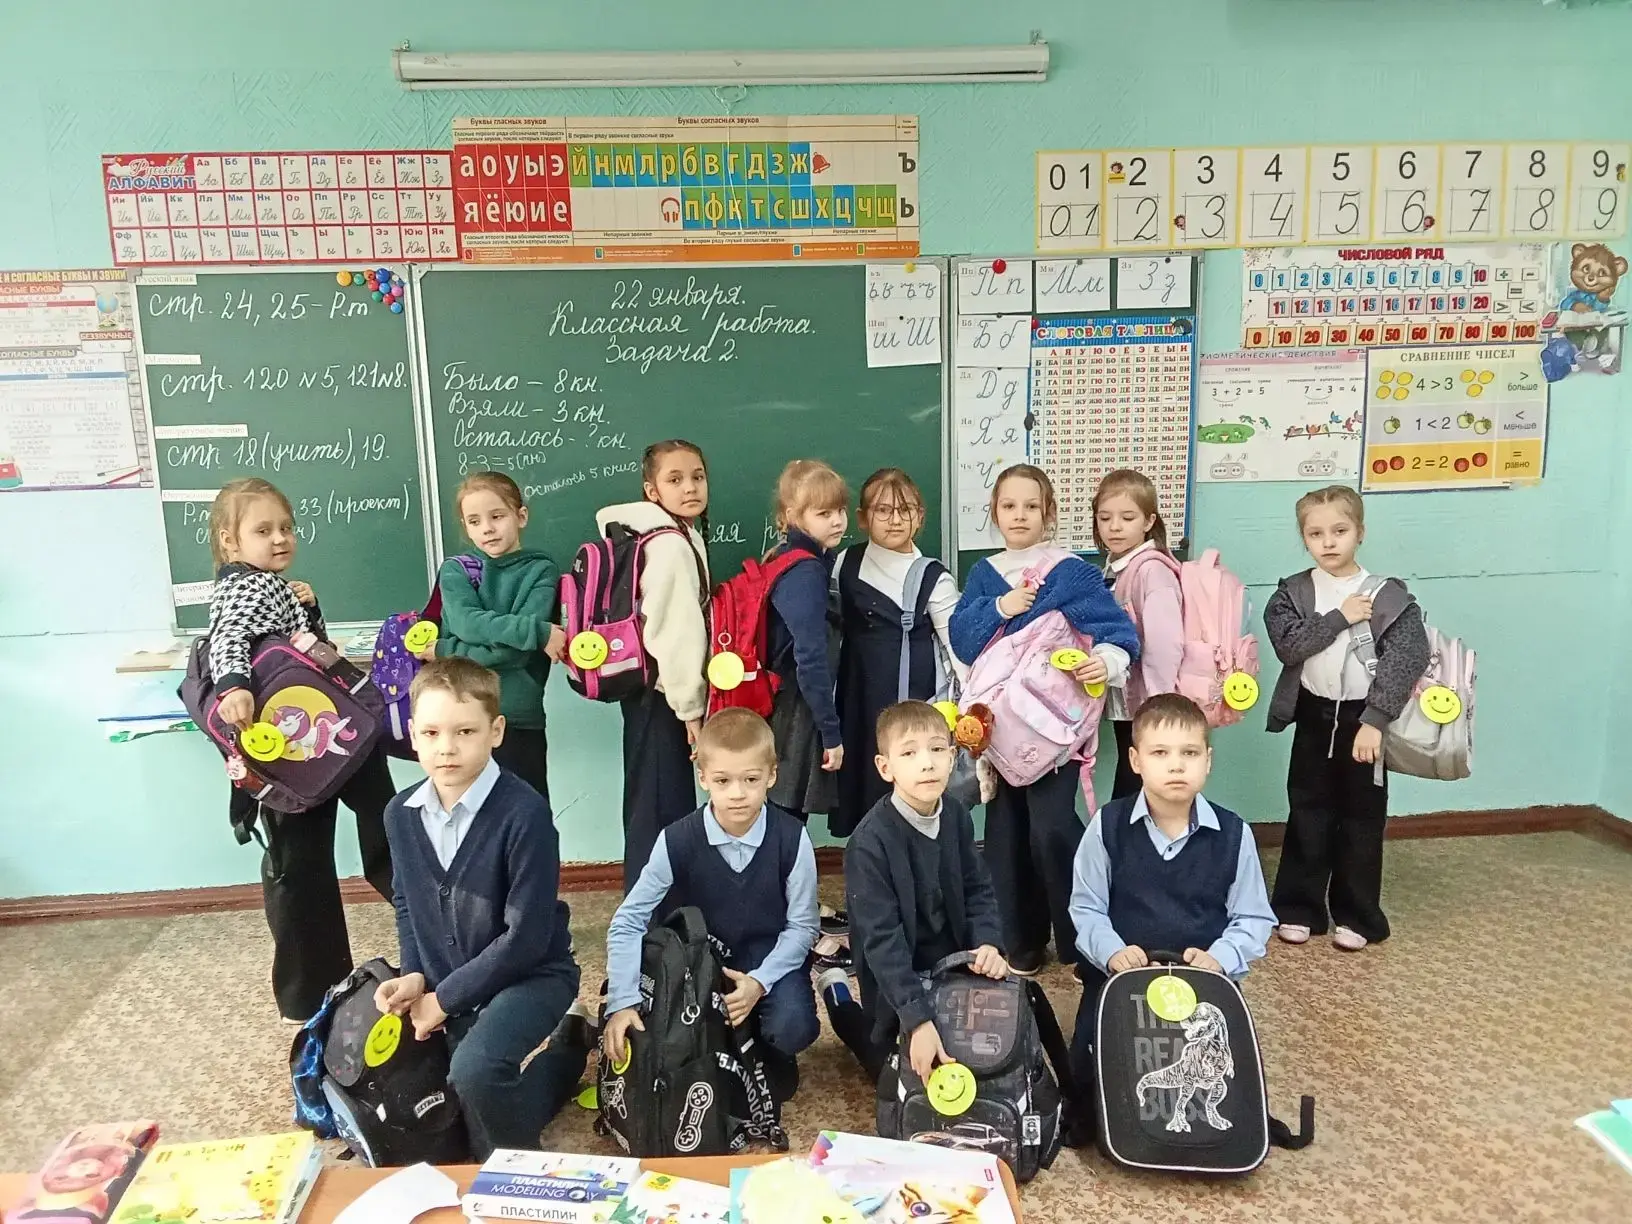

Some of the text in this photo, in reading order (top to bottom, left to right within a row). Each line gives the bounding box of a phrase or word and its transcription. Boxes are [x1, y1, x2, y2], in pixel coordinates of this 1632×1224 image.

[471, 118, 492, 126] Буквы
[678, 117, 699, 125] Буквы
[1049, 150, 1610, 190] 0 1 2 3 4 5 6 7 8 9
[109, 176, 195, 190] АЛФАВИТ
[1050, 188, 1618, 241] 0 1 2 3 4 5 6 7 8 9
[1338, 247, 1444, 261] ЧИСЛОВОЙ РЯД
[11, 272, 60, 282] СОГЛАСНЫЕ
[62, 271, 91, 280] БУКВЫ
[100, 270, 126, 279] ЗВУКИ
[1255, 269, 1486, 287] 0 1 2 3 4 5 6 7 8 9 10
[611, 280, 645, 310] 22
[549, 300, 689, 336] Классная
[1037, 326, 1113, 339] СЛОГОВАЯ
[1253, 325, 1535, 344] 0 10 20 30 40 50 60 70 80 90 100
[605, 335, 712, 374] Задача
[1400, 349, 1515, 362] СРАВНЕНИЕ ЧИСЕЛ
[243, 366, 289, 391] 120
[443, 361, 519, 391] Было
[1304, 386, 1309, 394] 7
[1351, 385, 1357, 393] 4
[1416, 377, 1453, 391] 4 3
[1508, 383, 1538, 392] больше
[1212, 387, 1264, 397] 3 2 5
[448, 392, 528, 428] Взяли
[1416, 416, 1450, 430] 1 2
[1504, 422, 1537, 431] меньше
[454, 419, 564, 448] Осталось
[1412, 456, 1449, 470] 2 2
[1505, 461, 1530, 470] равно
[501, 1207, 577, 1220] ПЛАСТИЛИН
